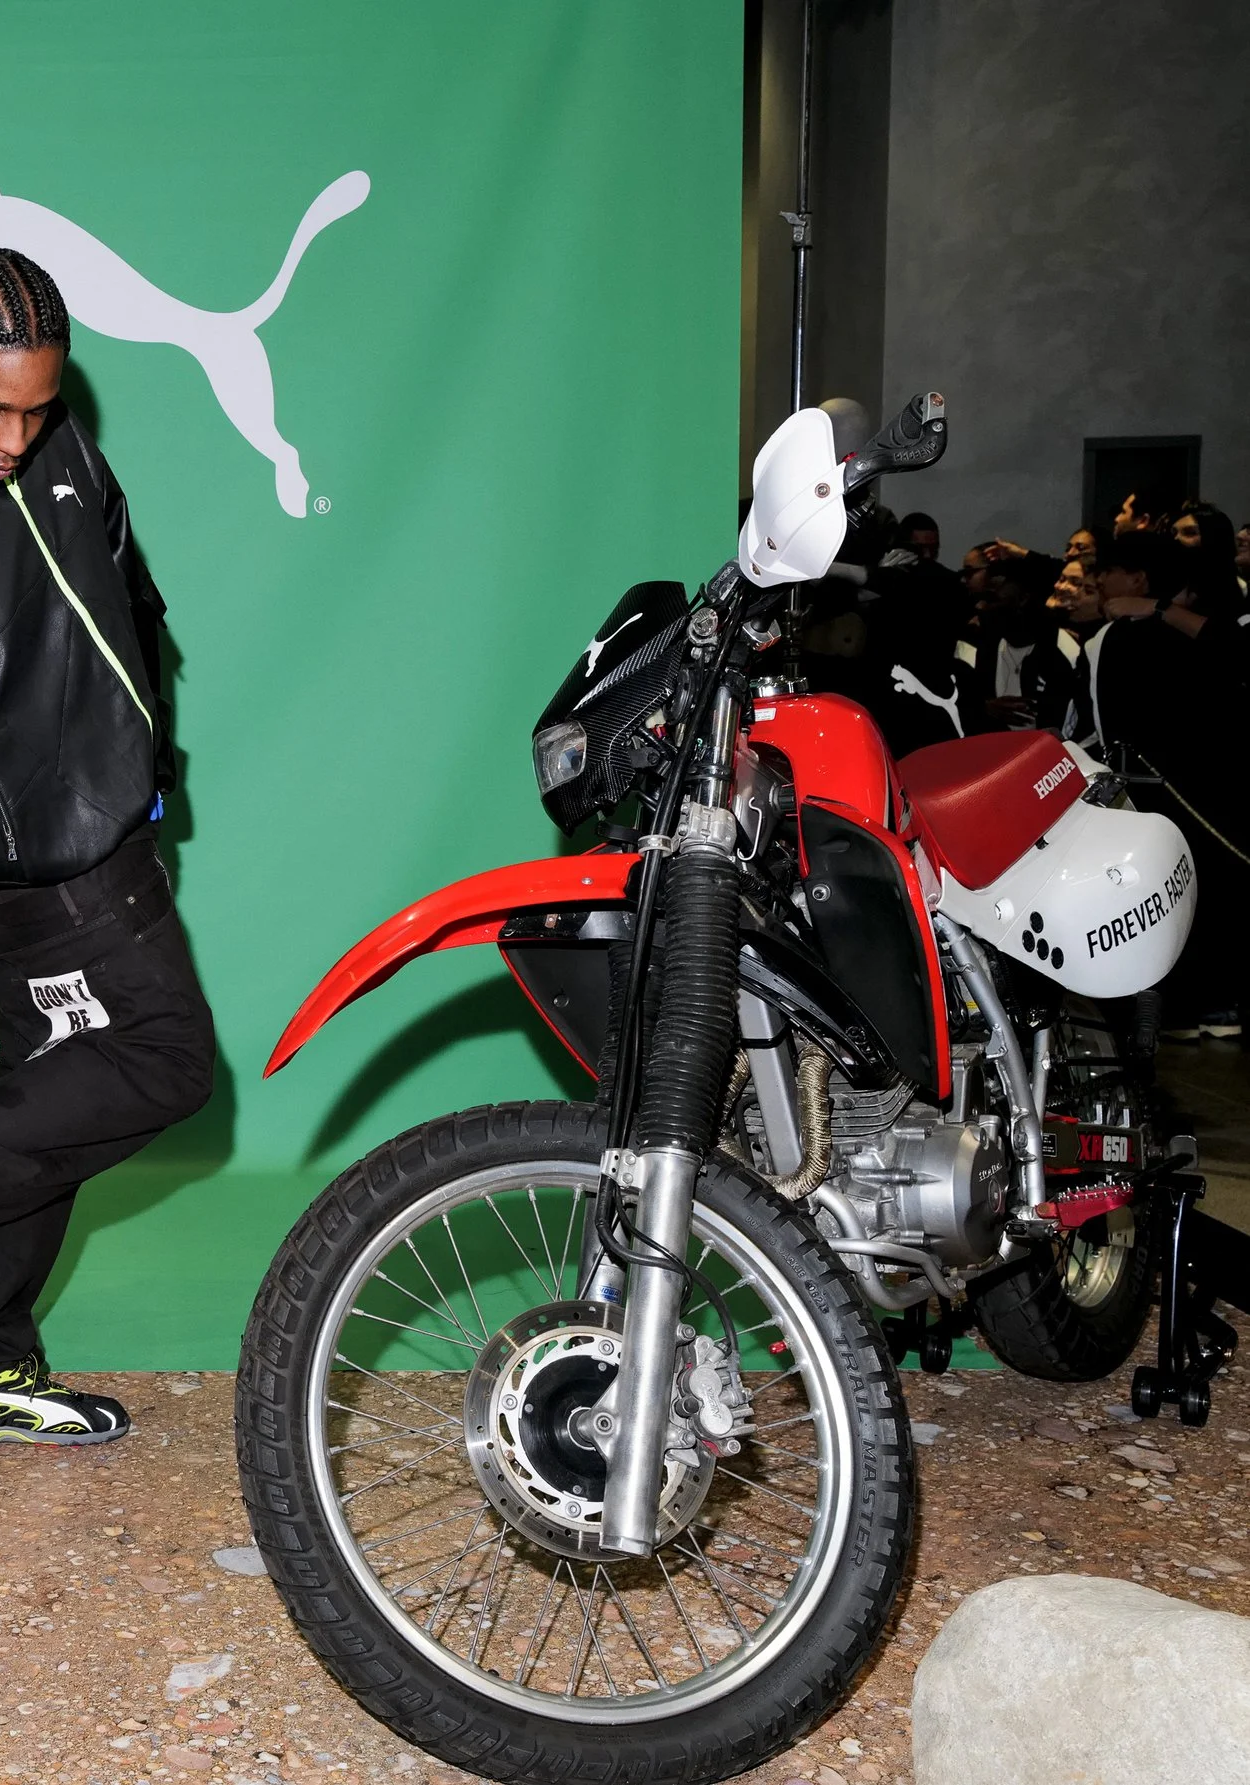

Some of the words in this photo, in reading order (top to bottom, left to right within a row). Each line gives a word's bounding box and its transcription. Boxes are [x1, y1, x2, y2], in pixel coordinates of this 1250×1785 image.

[1033, 757, 1076, 800] HONDA
[1086, 892, 1170, 959] FOREVER.
[1164, 853, 1193, 909] FASTER.
[33, 979, 91, 1010] DON'T
[835, 1335, 872, 1423] TRAIL
[853, 1439, 878, 1568] MASTER
